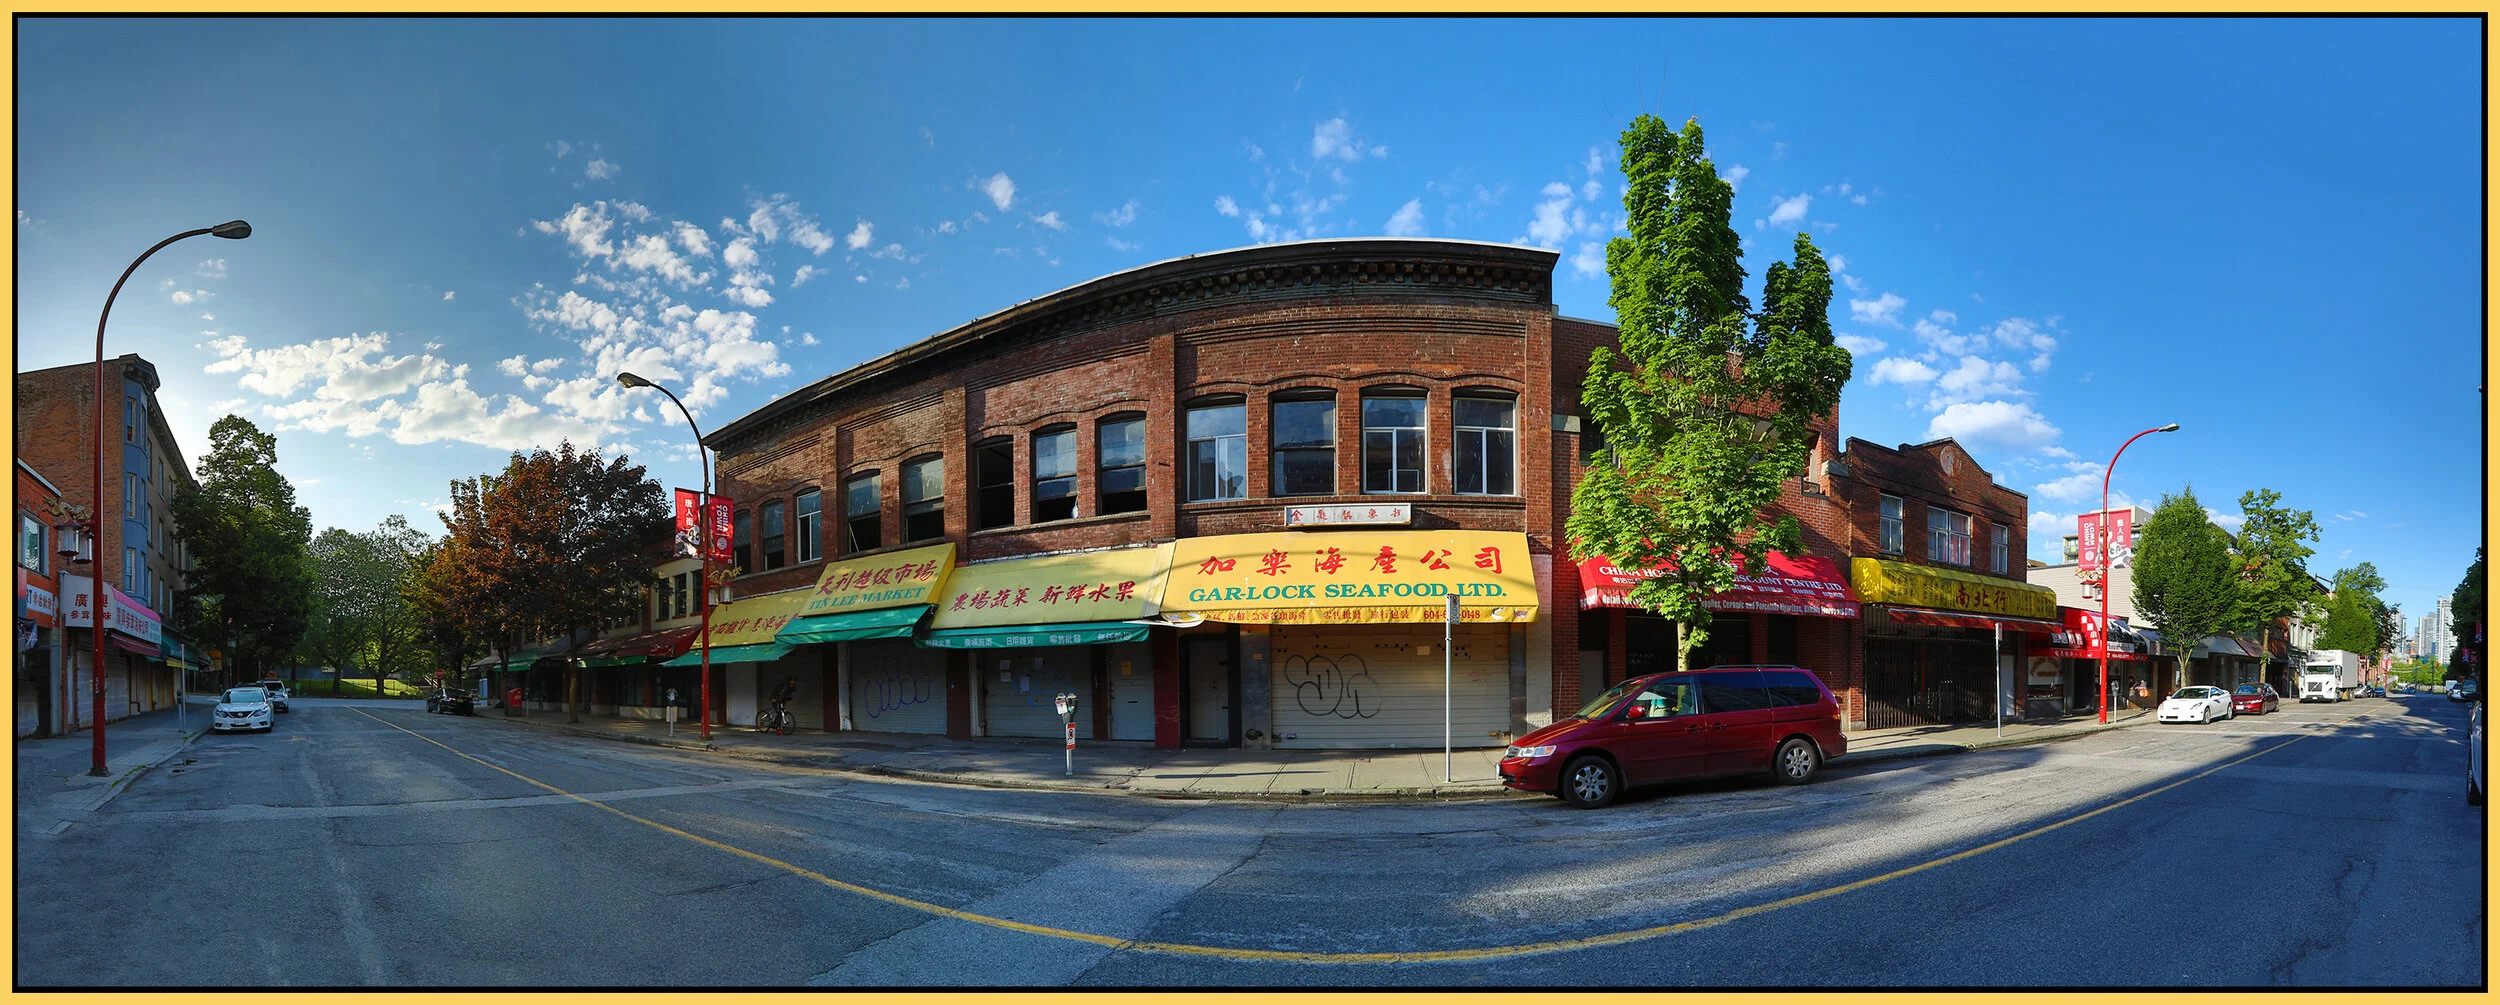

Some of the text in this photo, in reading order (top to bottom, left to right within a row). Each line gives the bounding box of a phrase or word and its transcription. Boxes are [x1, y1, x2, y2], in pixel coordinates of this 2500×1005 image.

[1197, 545, 1503, 577] 加樂海產公司
[948, 580, 1137, 612] 農場蔬菜 新鮮水果
[1188, 582, 1508, 603] GAR-LOCK SEAFOOD LTD.
[1784, 578, 1825, 590] CENTRE
[1824, 582, 1846, 592] LTD.
[808, 587, 926, 611] TIN LEE MARKET
[1955, 583, 2008, 612] 南北行
[70, 610, 112, 620] 參茸味
[1423, 609, 1481, 619] 604-6-0148
